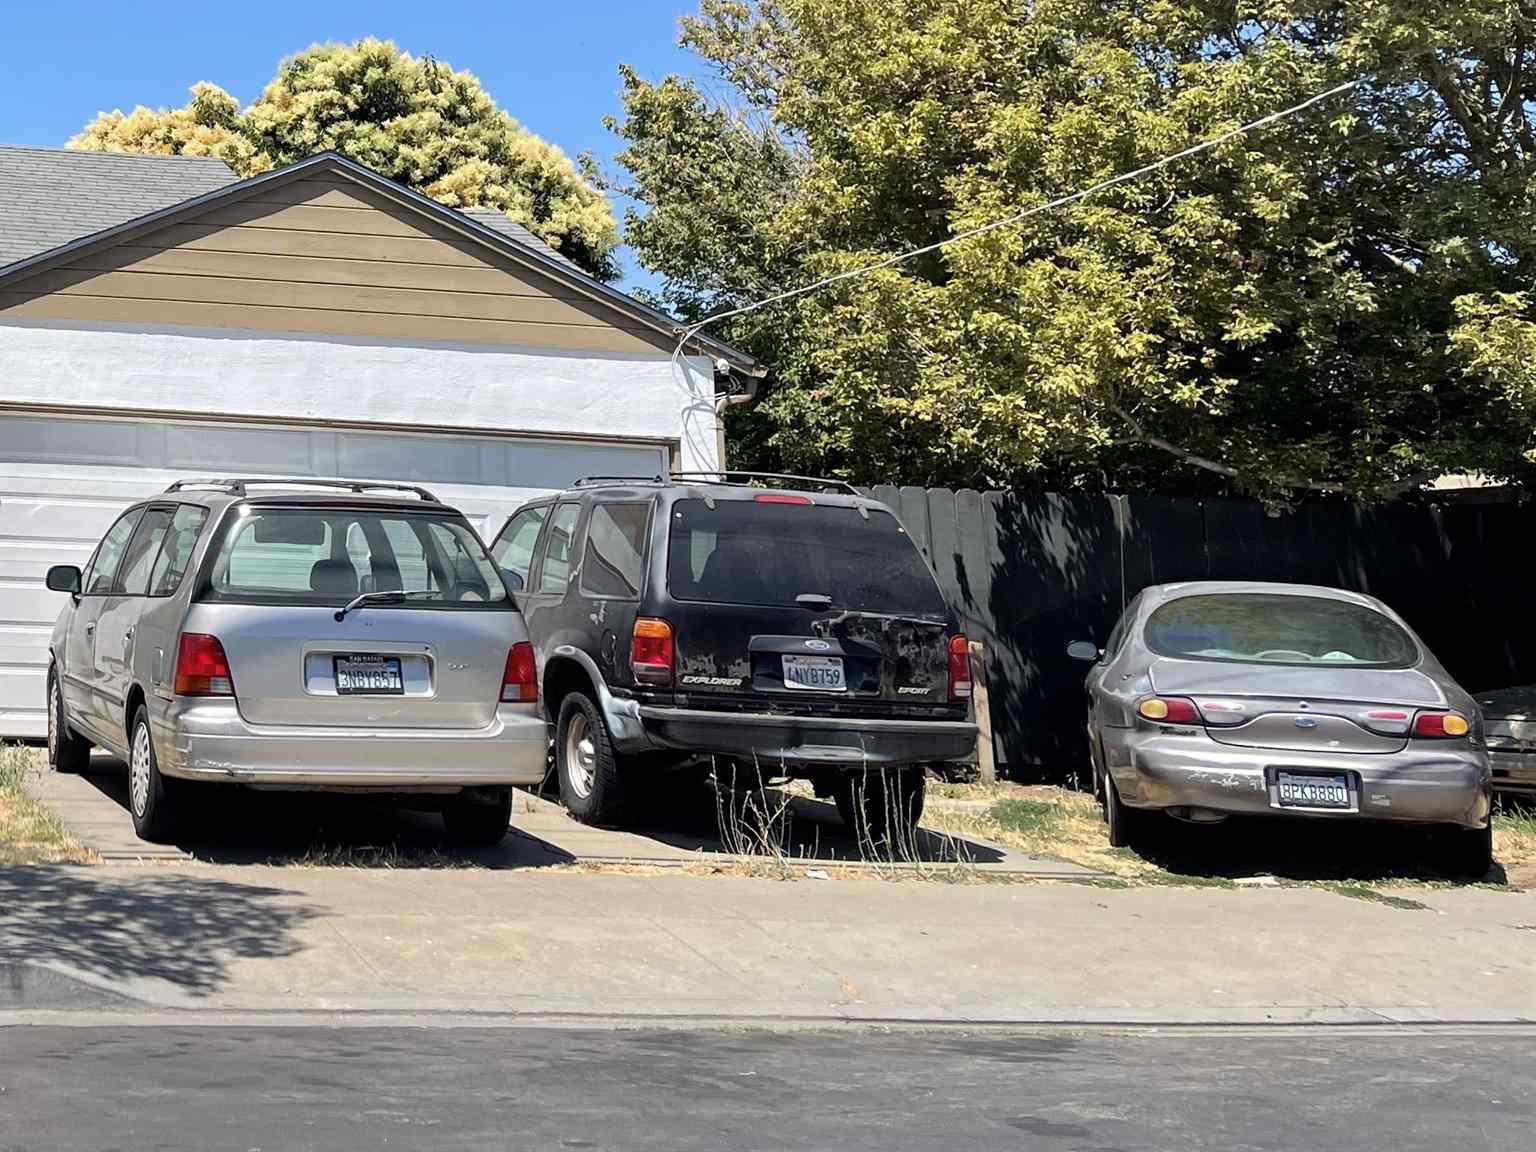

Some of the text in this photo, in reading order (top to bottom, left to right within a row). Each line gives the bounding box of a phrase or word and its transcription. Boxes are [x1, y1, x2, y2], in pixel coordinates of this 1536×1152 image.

[682, 675, 743, 686] EXPLORER
[897, 686, 931, 695] SPORT
[1282, 783, 1344, 801] 8PKB880
